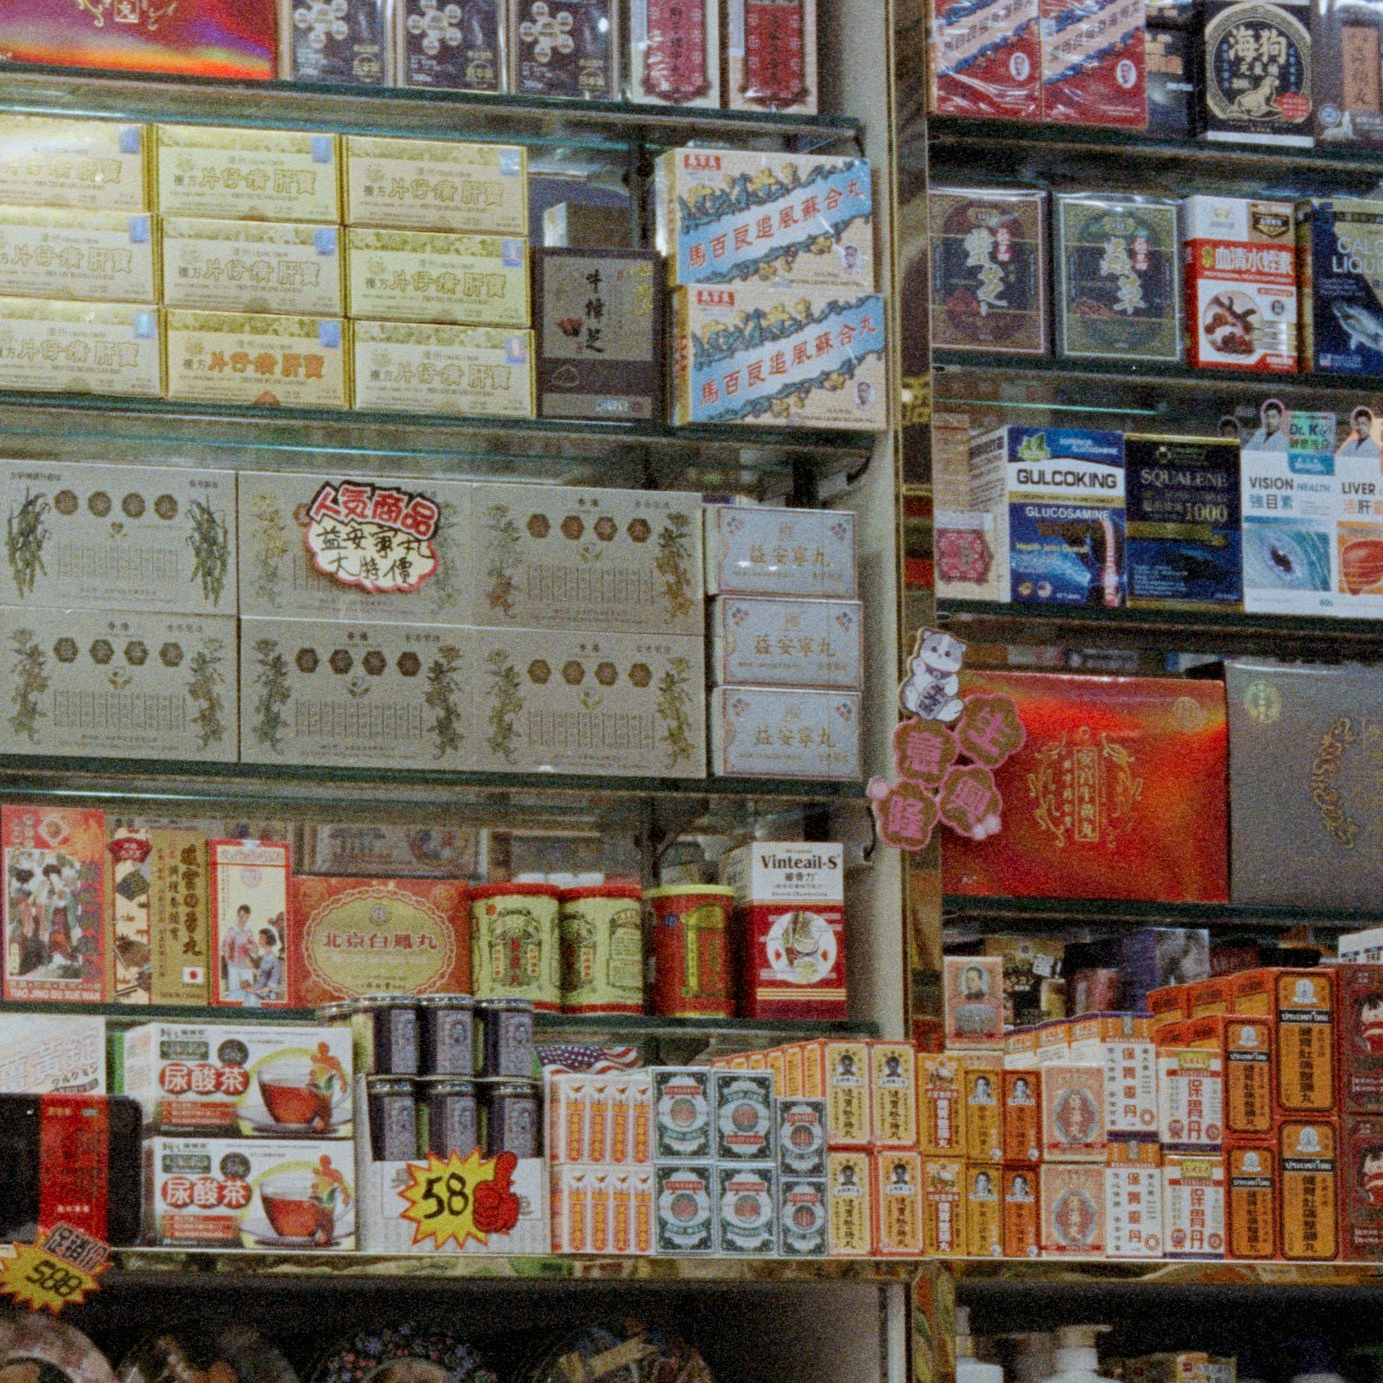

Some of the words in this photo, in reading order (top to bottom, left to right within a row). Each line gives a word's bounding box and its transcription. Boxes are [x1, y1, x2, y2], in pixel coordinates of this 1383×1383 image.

[1228, 26, 1287, 62] 海狗
[1015, 468, 1118, 490] GULCOKING
[1140, 468, 1228, 487] SQUALENE
[1248, 476, 1294, 491] VISION
[1341, 480, 1377, 496] LIVER
[1024, 507, 1110, 521] GLUCOSAMINE
[327, 552, 414, 588] 大特價
[322, 930, 438, 952] 北京白鳳丸
[162, 1065, 247, 1092] 尿酸茶
[162, 1181, 248, 1207] 尿酸茶
[421, 1172, 472, 1222] 58
[26, 1258, 84, 1298] 588
